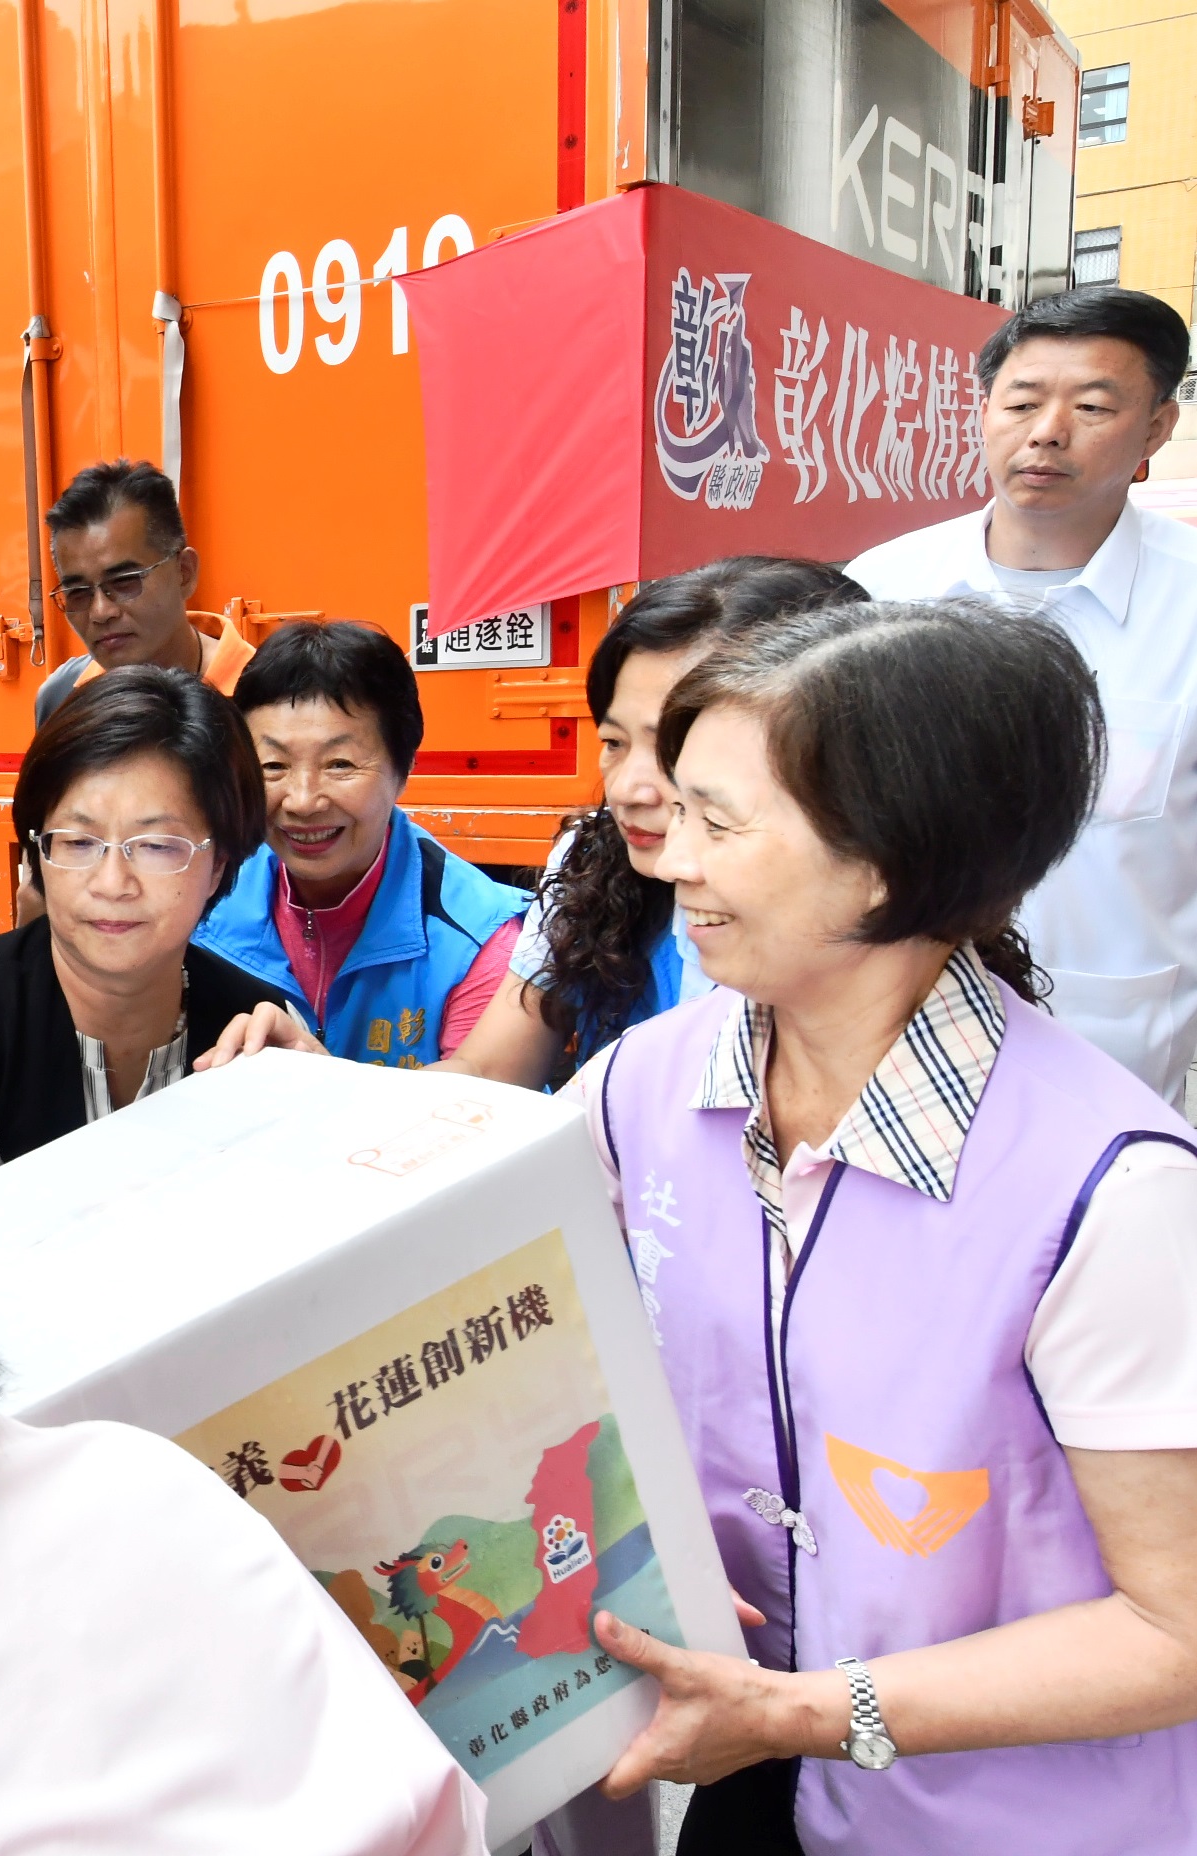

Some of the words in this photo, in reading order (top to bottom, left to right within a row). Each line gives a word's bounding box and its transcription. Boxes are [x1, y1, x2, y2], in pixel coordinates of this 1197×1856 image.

[707, 462, 761, 503] 縣政府
[325, 1283, 555, 1441] 花蓮創新機
[552, 1553, 589, 1580] Hualien
[468, 1629, 651, 1758] 彰化縣政府為您
